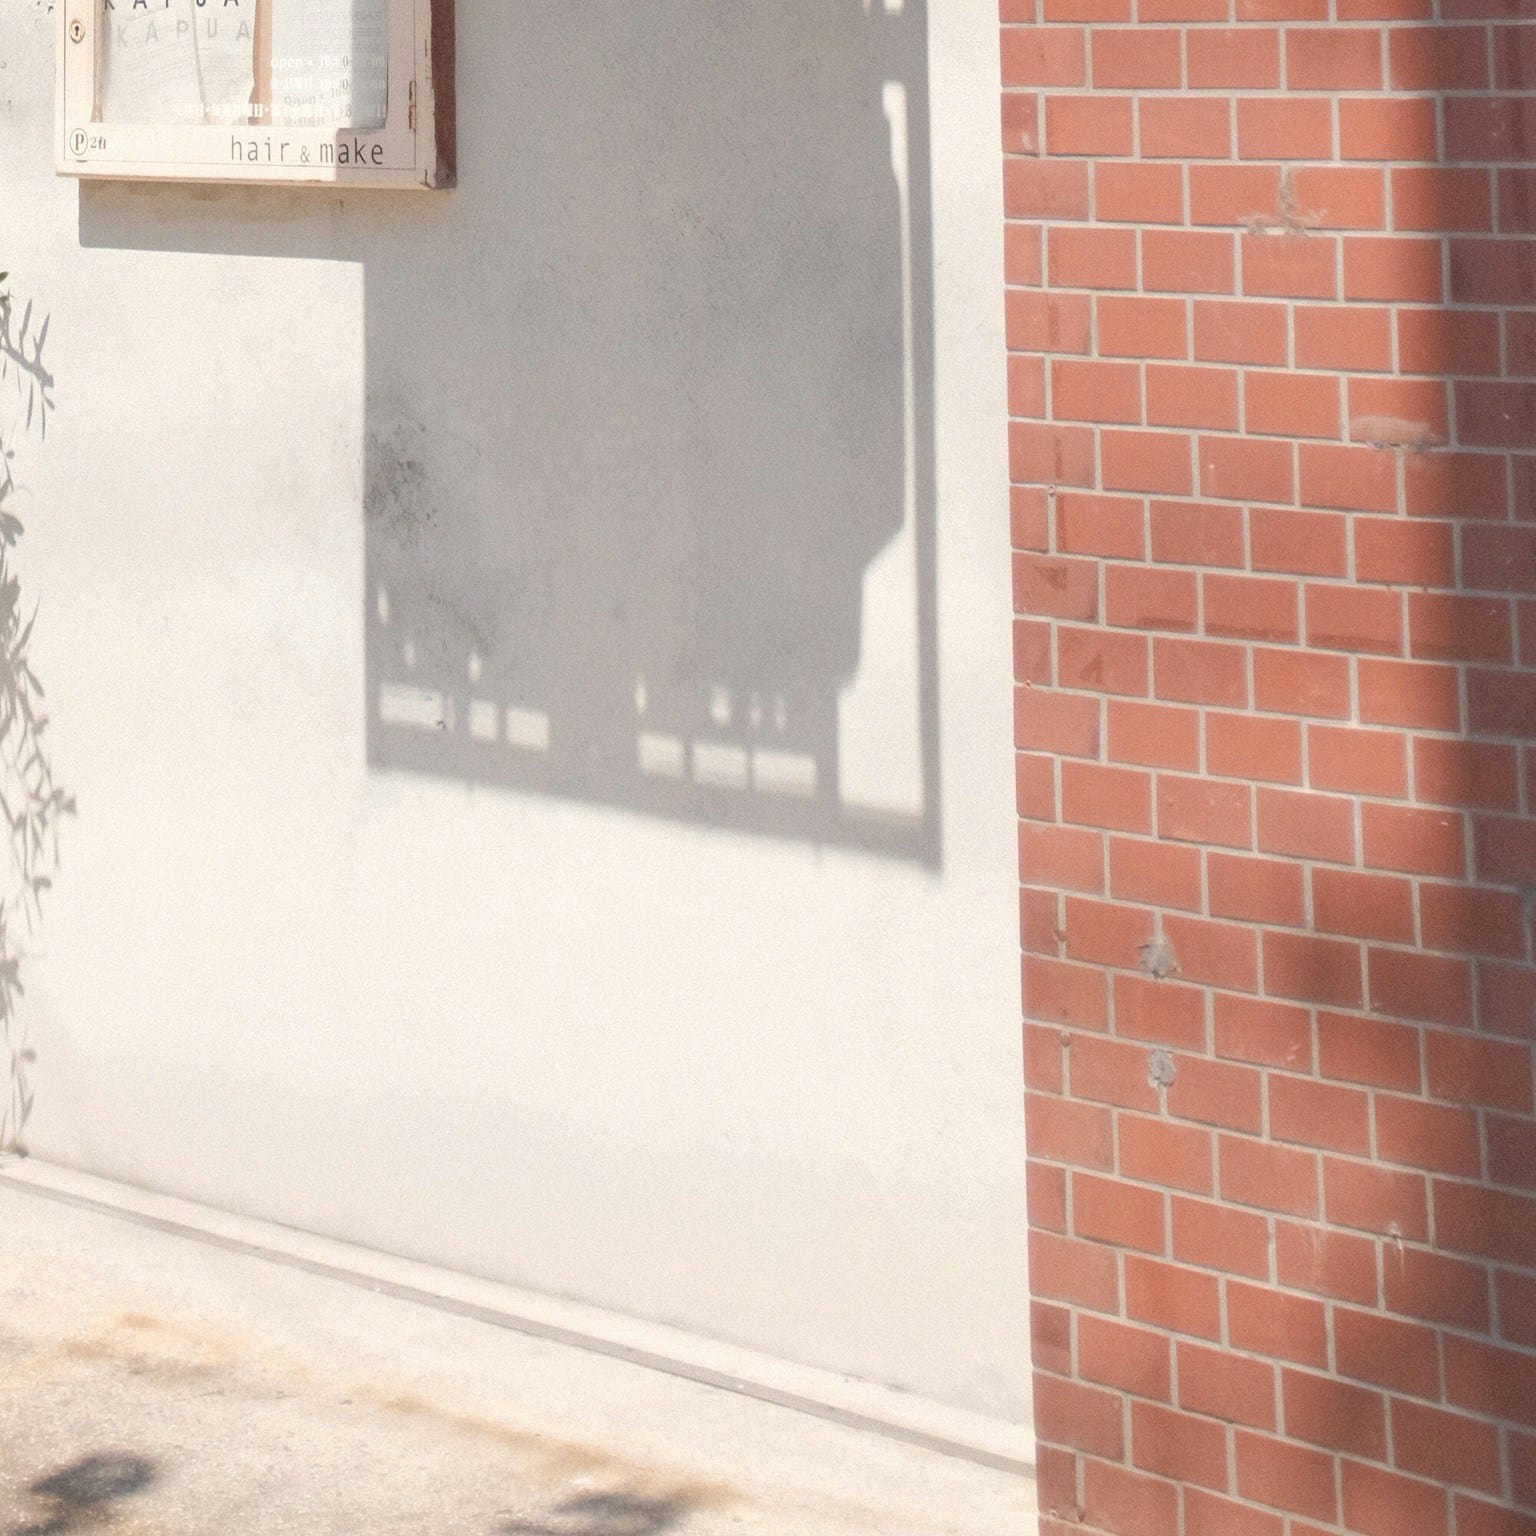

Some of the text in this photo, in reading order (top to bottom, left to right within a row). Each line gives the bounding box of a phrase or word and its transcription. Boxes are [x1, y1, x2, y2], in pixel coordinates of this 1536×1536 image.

[230, 135, 384, 166] hair & make
